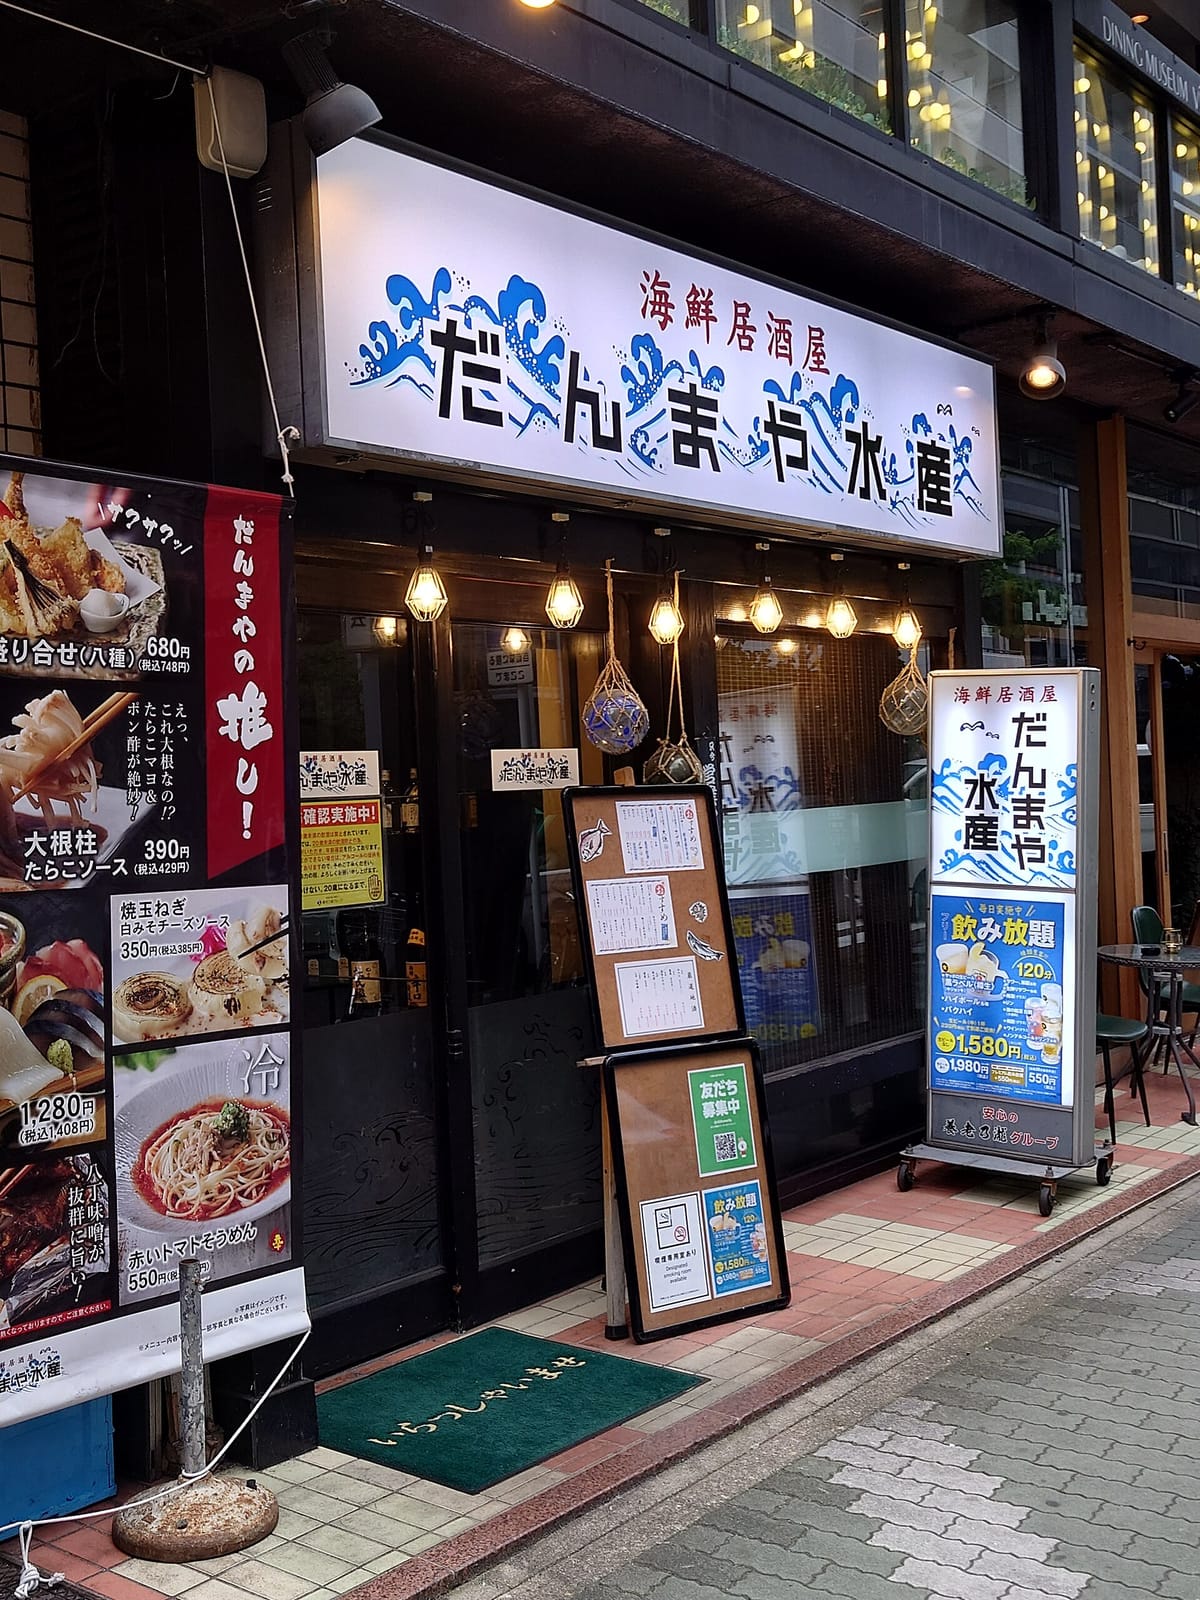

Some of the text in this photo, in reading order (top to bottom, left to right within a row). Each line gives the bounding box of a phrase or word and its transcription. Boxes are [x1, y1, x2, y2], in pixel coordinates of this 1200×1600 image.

[1103, 15, 1143, 67] DINING
[1145, 50, 1188, 102] MUSEUM
[639, 269, 831, 376] 海鮮居酒屋
[430, 317, 955, 517] だんまや水産
[107, 501, 183, 549] サクサクッ
[147, 637, 190, 660] 680円
[138, 660, 190, 674] (税込748円)
[954, 685, 1058, 705] 海鮮居酒屋
[175, 702, 188, 743] えっ、
[502, 765, 570, 782] だんまや水産
[1011, 712, 1047, 870] だんまや
[301, 805, 376, 825] 確認実施中!
[963, 773, 1000, 852] 水産
[24, 829, 98, 858] 大根柱
[144, 839, 190, 860] 390円
[24, 858, 129, 881] たらこソース
[134, 861, 190, 876] (税込429円)
[120, 897, 187, 920] 焼玉ねぎ
[120, 915, 231, 937] 白みそチーズソース
[951, 913, 1057, 948] 飲み放題
[1017, 962, 1054, 980] 120分
[957, 1034, 1021, 1060] 1,580円
[241, 1041, 285, 1097] 冷
[949, 1058, 989, 1075] 1,980円
[699, 1079, 738, 1099] 友だち
[1029, 1072, 1056, 1086] 550円
[20, 1093, 94, 1128] 1,280円
[702, 1098, 740, 1119] 募集中
[982, 1107, 1019, 1123] 安心の
[19, 1118, 94, 1147] (税込1,408円)
[86, 1163, 105, 1264] 八丁味噌が
[713, 1193, 757, 1214] 飲み放題
[68, 1187, 87, 1302] 抜群に旨い!
[128, 1223, 257, 1271] 赤いトマトそうめん
[367, 1355, 587, 1446] いらっしゃいませ
